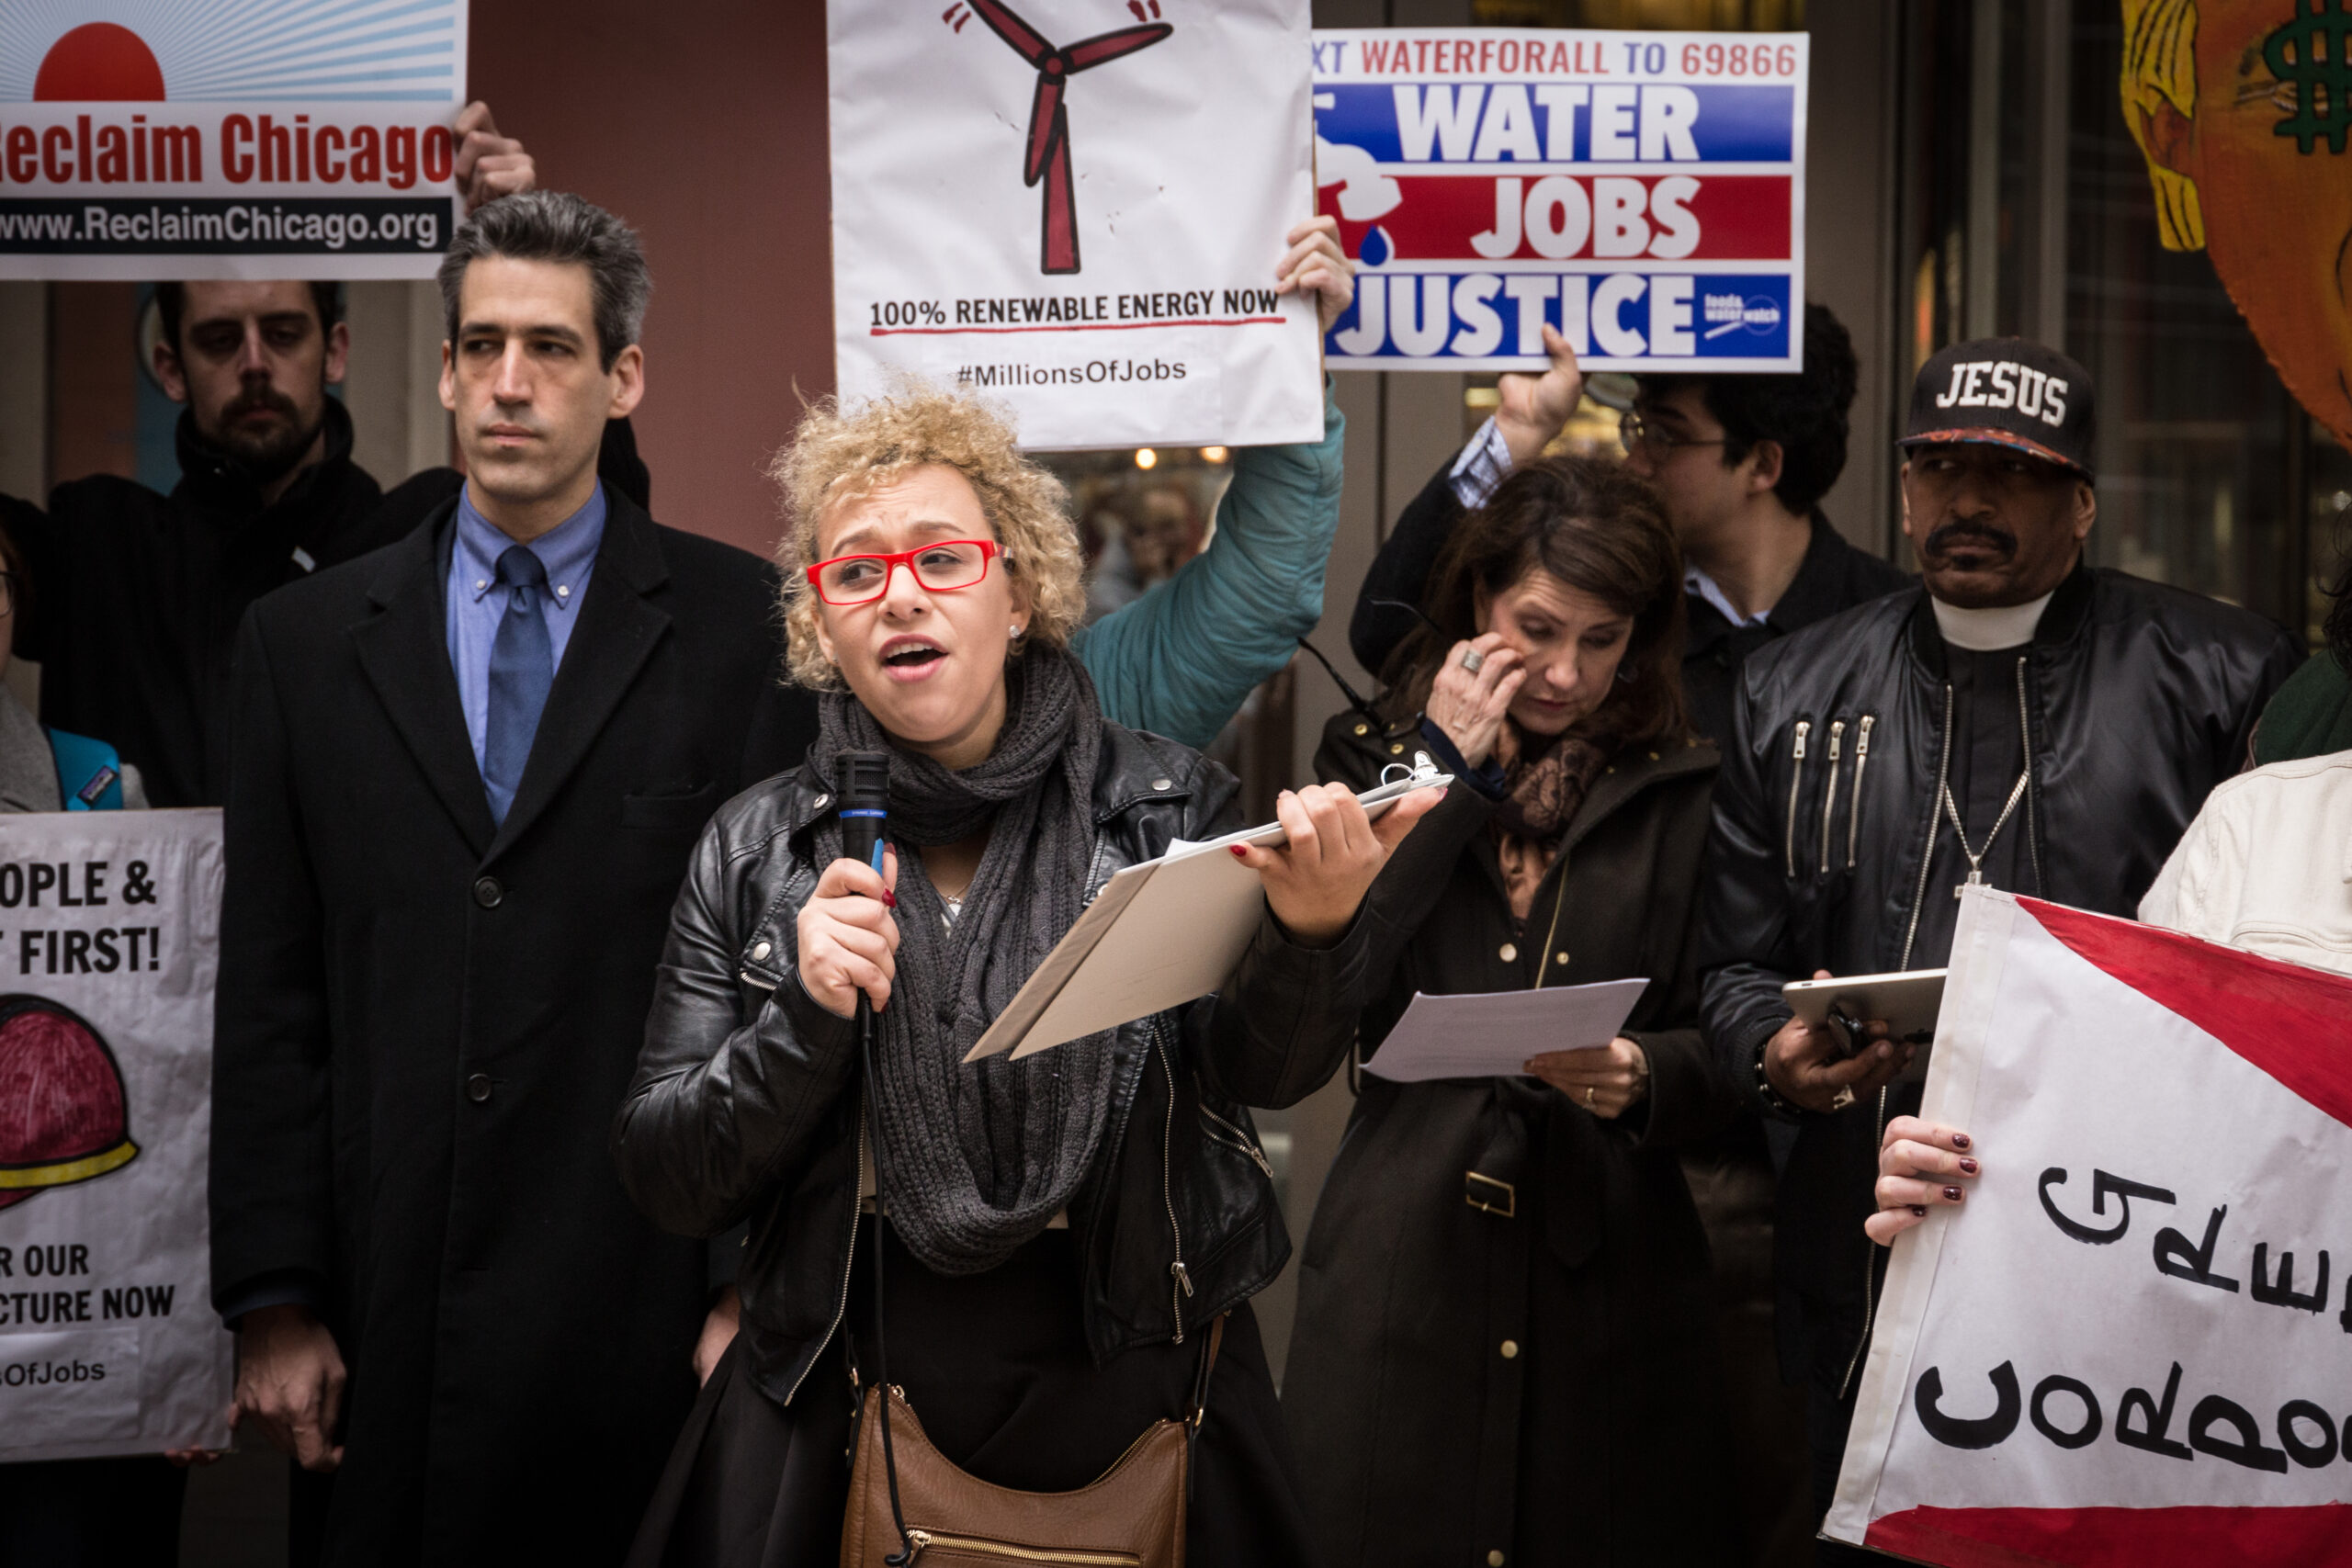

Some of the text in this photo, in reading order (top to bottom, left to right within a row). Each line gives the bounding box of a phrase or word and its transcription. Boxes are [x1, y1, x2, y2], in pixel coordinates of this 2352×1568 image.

[1362, 39, 1609, 73] WATERFORALL
[1623, 42, 1667, 74] TO
[1681, 43, 1796, 76] 69866
[1392, 85, 1701, 161] WATER
[0, 113, 454, 190] eclaim Chicago
[0, 206, 438, 249] www.ReclaimChicago.org
[1470, 175, 1702, 259] JOBS
[871, 288, 1279, 327] 100% RENEWABLE ENERGY NOW
[1335, 273, 1696, 357] JUSTICE
[957, 358, 1186, 387] #MillionsOfJobs
[1936, 360, 2068, 427] JESUS
[121, 860, 157, 905] &
[19, 926, 160, 975] FIRST!
[24, 1244, 90, 1278] OUR
[2038, 1167, 2352, 1334] GRE
[102, 1284, 175, 1320] NOW
[1915, 1359, 2352, 1474] CORPO
